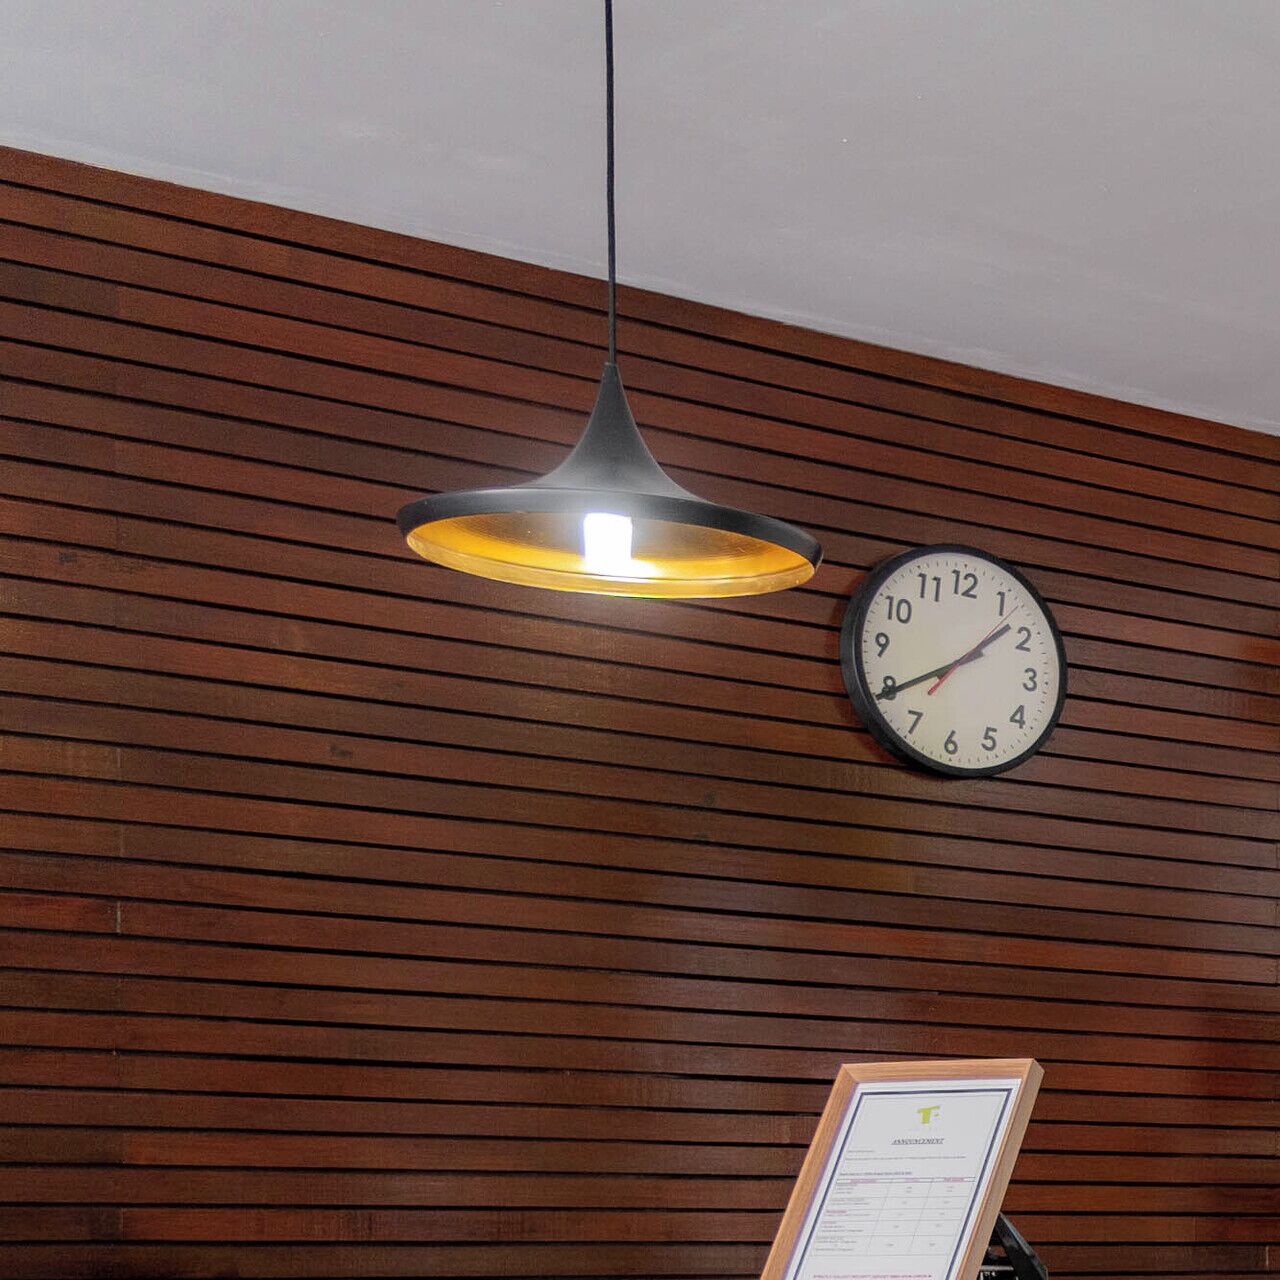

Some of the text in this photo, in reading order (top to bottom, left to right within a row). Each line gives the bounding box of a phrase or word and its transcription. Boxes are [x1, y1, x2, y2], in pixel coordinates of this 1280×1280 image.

[918, 573, 941, 601] 11
[952, 570, 978, 598] 12
[886, 595, 911, 623] 10
[997, 591, 1006, 616] 1
[875, 633, 890, 657] 9
[1015, 627, 1031, 651] 2
[1023, 668, 1037, 691] 3
[908, 710, 923, 734] 7
[1010, 705, 1025, 729] 4
[944, 730, 957, 755] 6
[981, 727, 997, 751] 5
